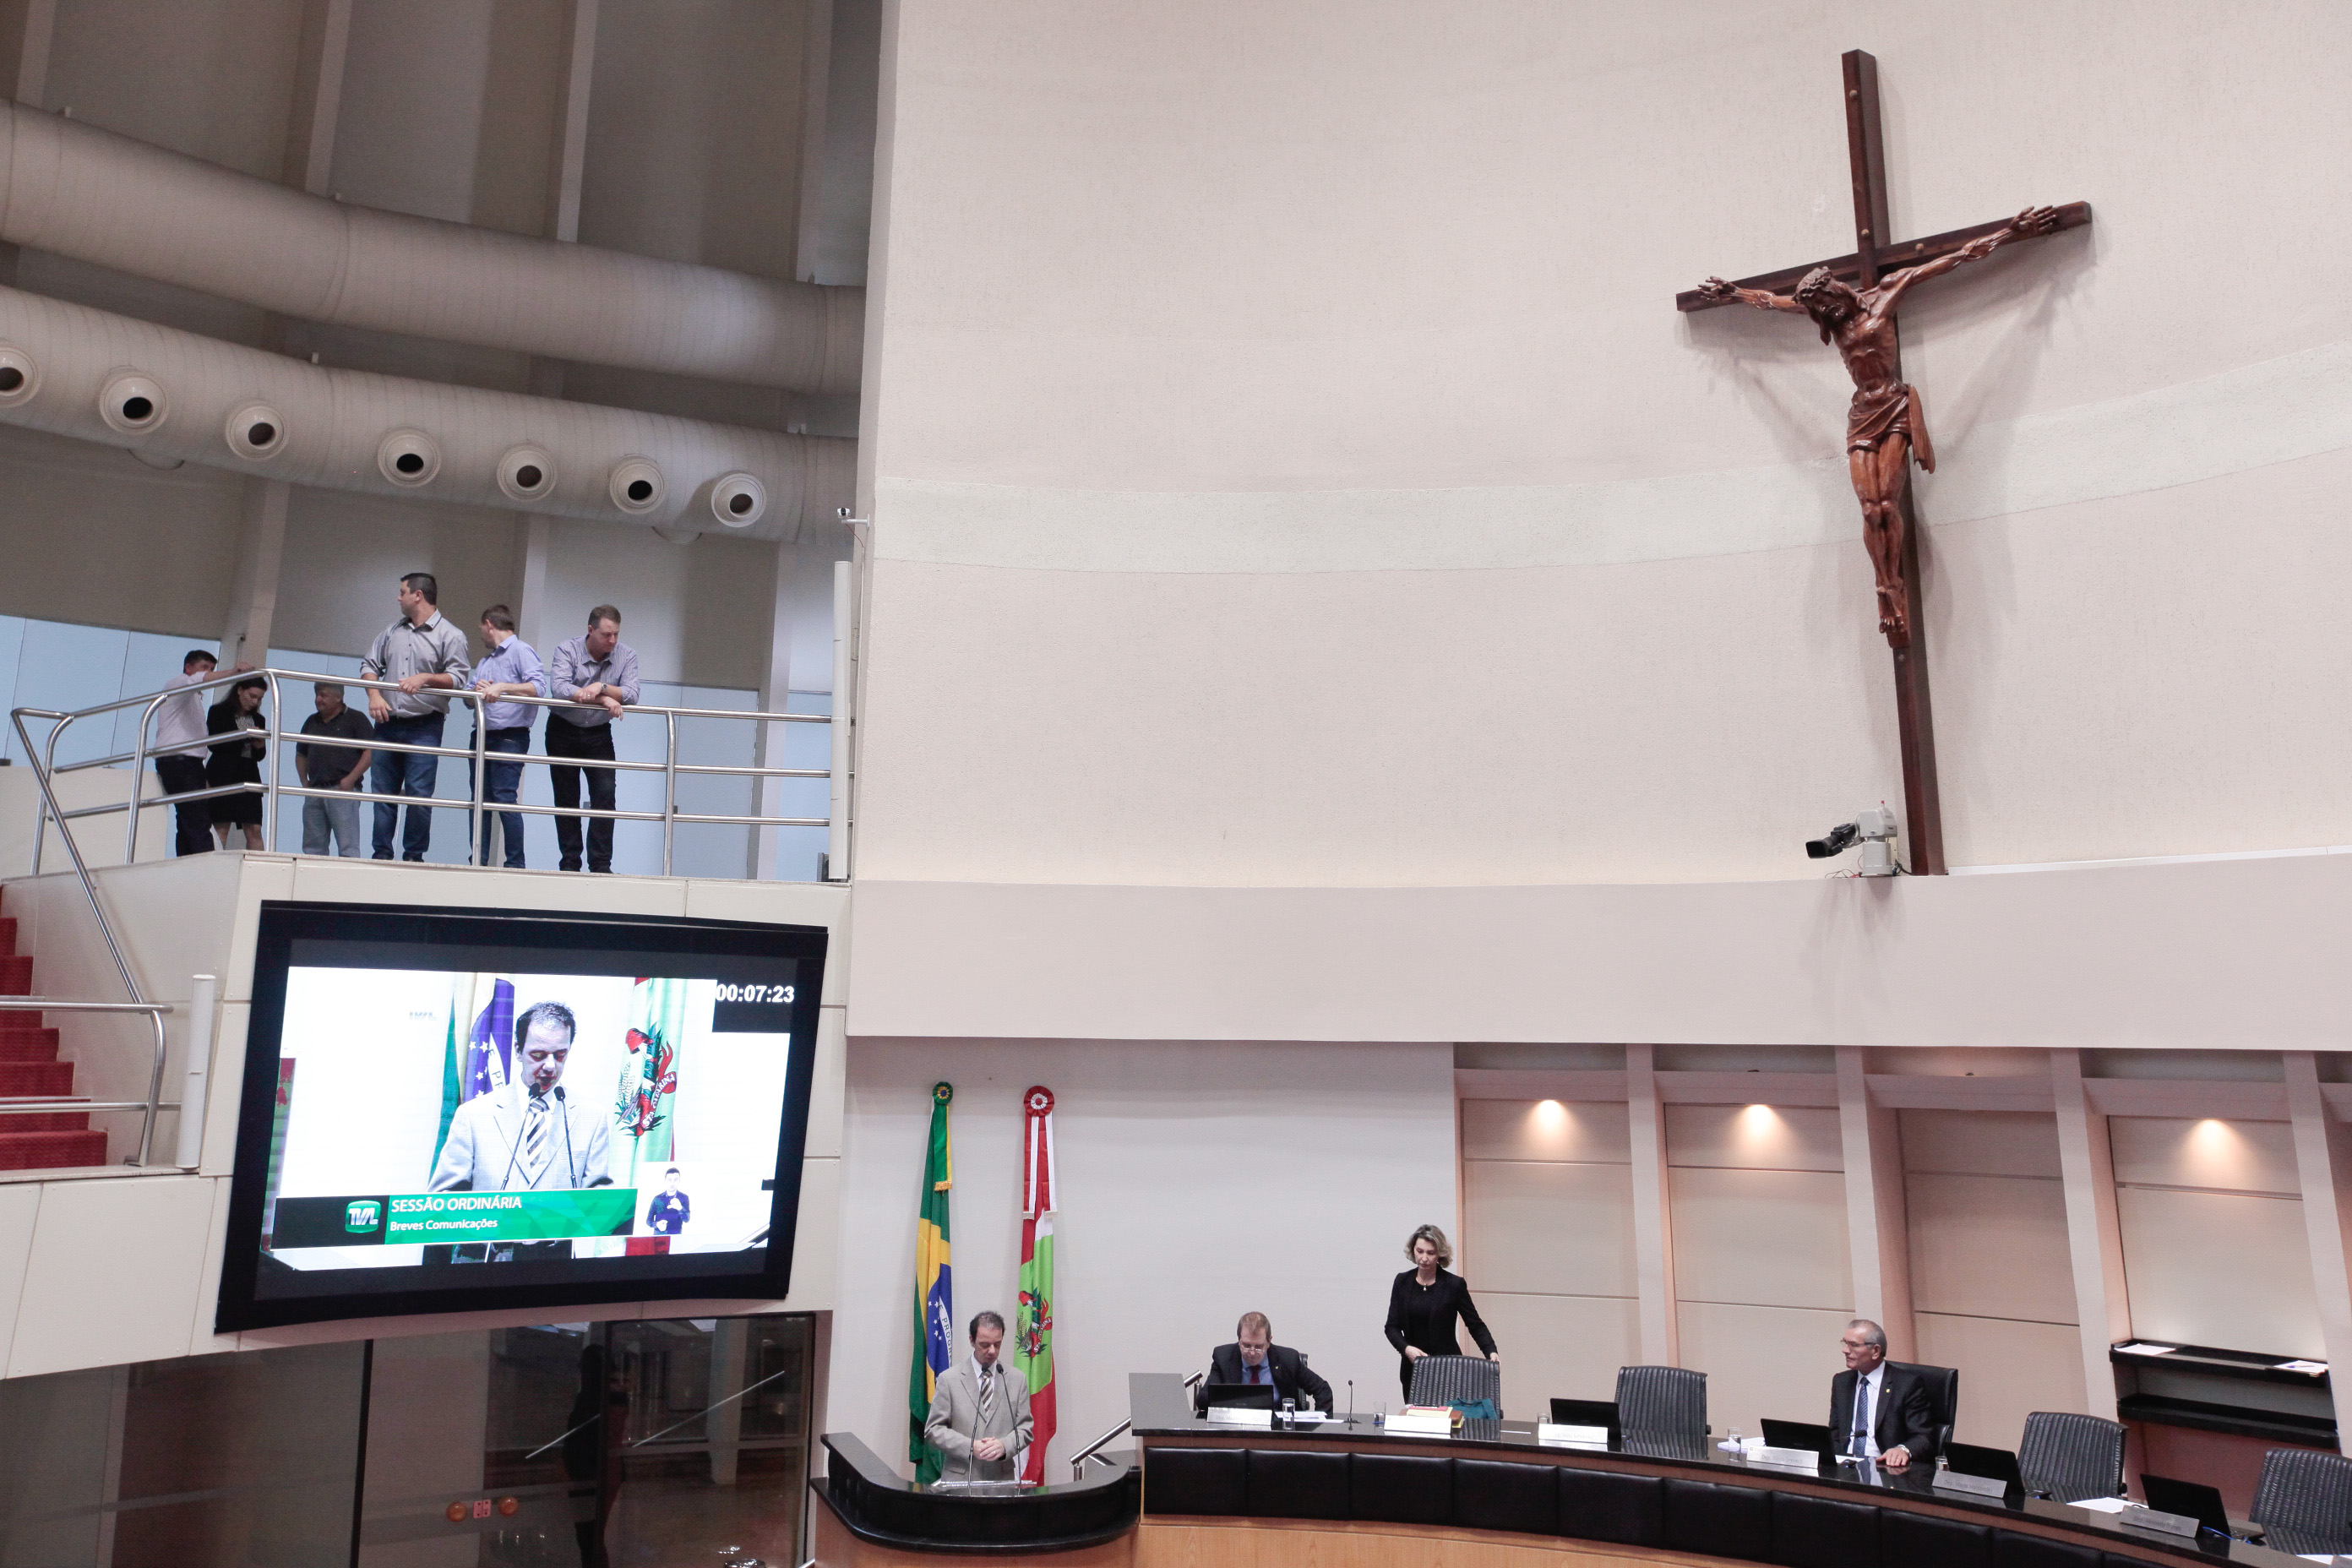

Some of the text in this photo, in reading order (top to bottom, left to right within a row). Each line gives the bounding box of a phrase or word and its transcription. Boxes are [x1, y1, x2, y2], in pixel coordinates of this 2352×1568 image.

[716, 983, 795, 1003] 00:07:23
[391, 1195, 522, 1212] SESSÃO ORDINÁRIA
[348, 1207, 378, 1226] TVL
[389, 1218, 498, 1232] Breves Comunicações
